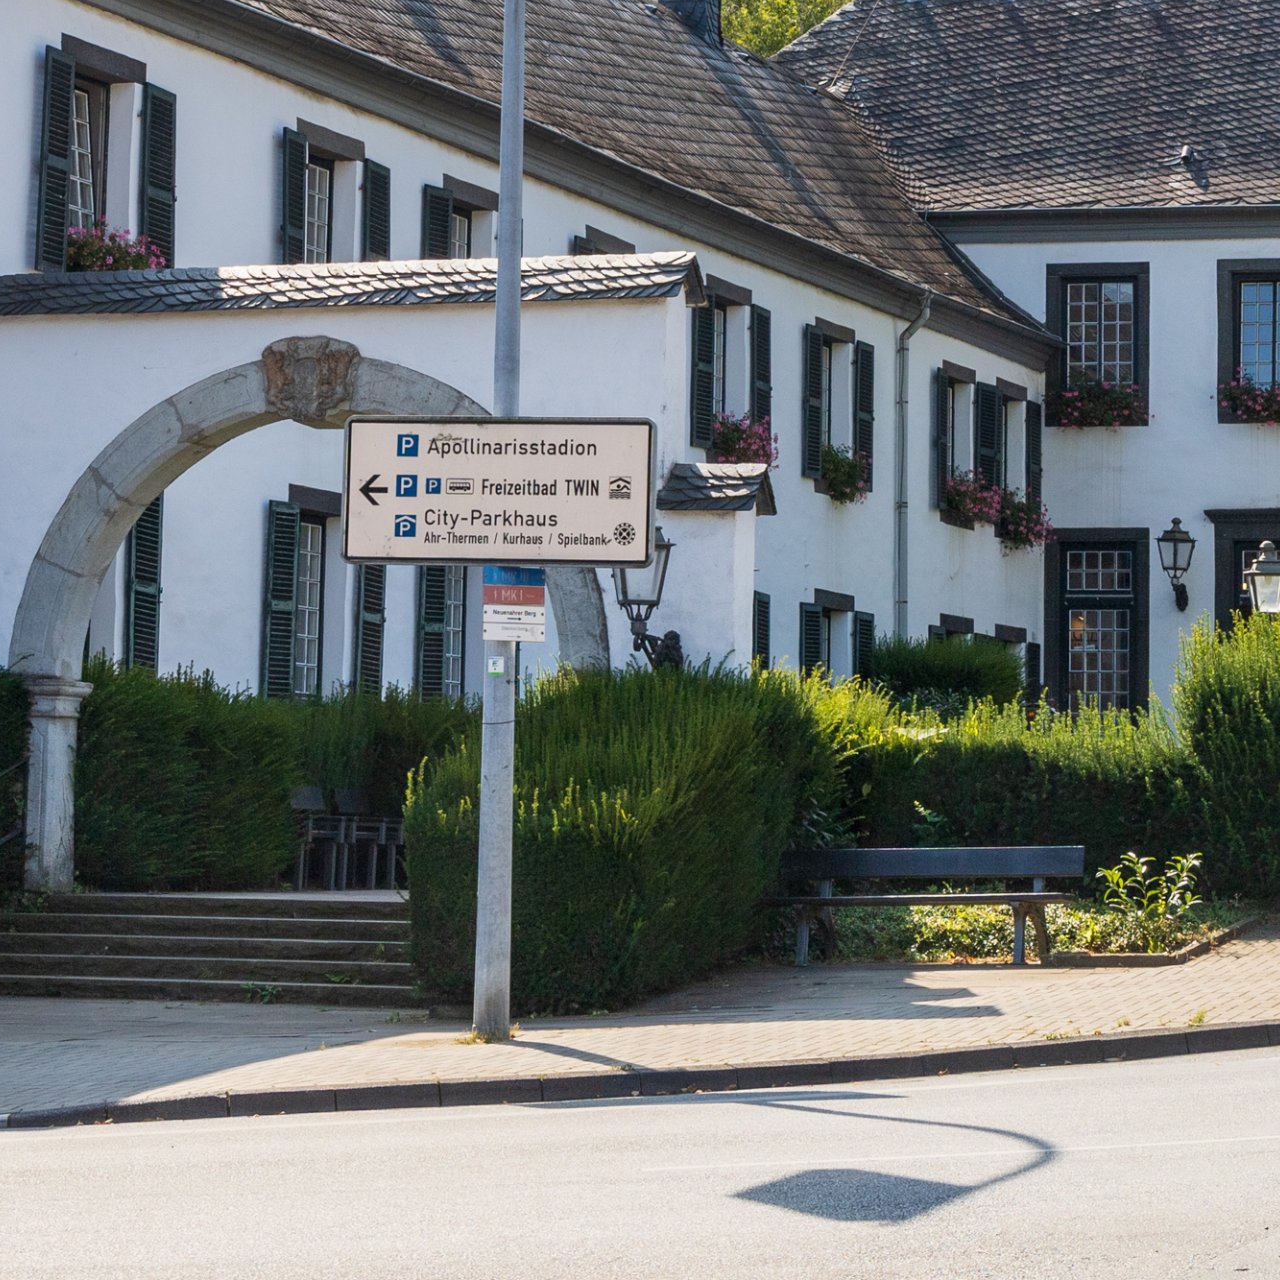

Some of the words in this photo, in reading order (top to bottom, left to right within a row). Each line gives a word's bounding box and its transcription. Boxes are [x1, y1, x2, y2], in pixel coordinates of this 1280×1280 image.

[401, 437, 414, 454] P
[427, 438, 597, 458] Apollinarisstadion
[400, 477, 413, 495] P
[481, 478, 557, 496] Freizeitbad
[564, 479, 600, 497] TWIN
[424, 509, 558, 530] City-Parkhaus
[424, 532, 489, 544] Ahr-Thermen
[503, 533, 544, 545] Kurhaus
[558, 533, 607, 548] Spielbank
[501, 589, 517, 601] MK
[524, 610, 537, 618] Berg
